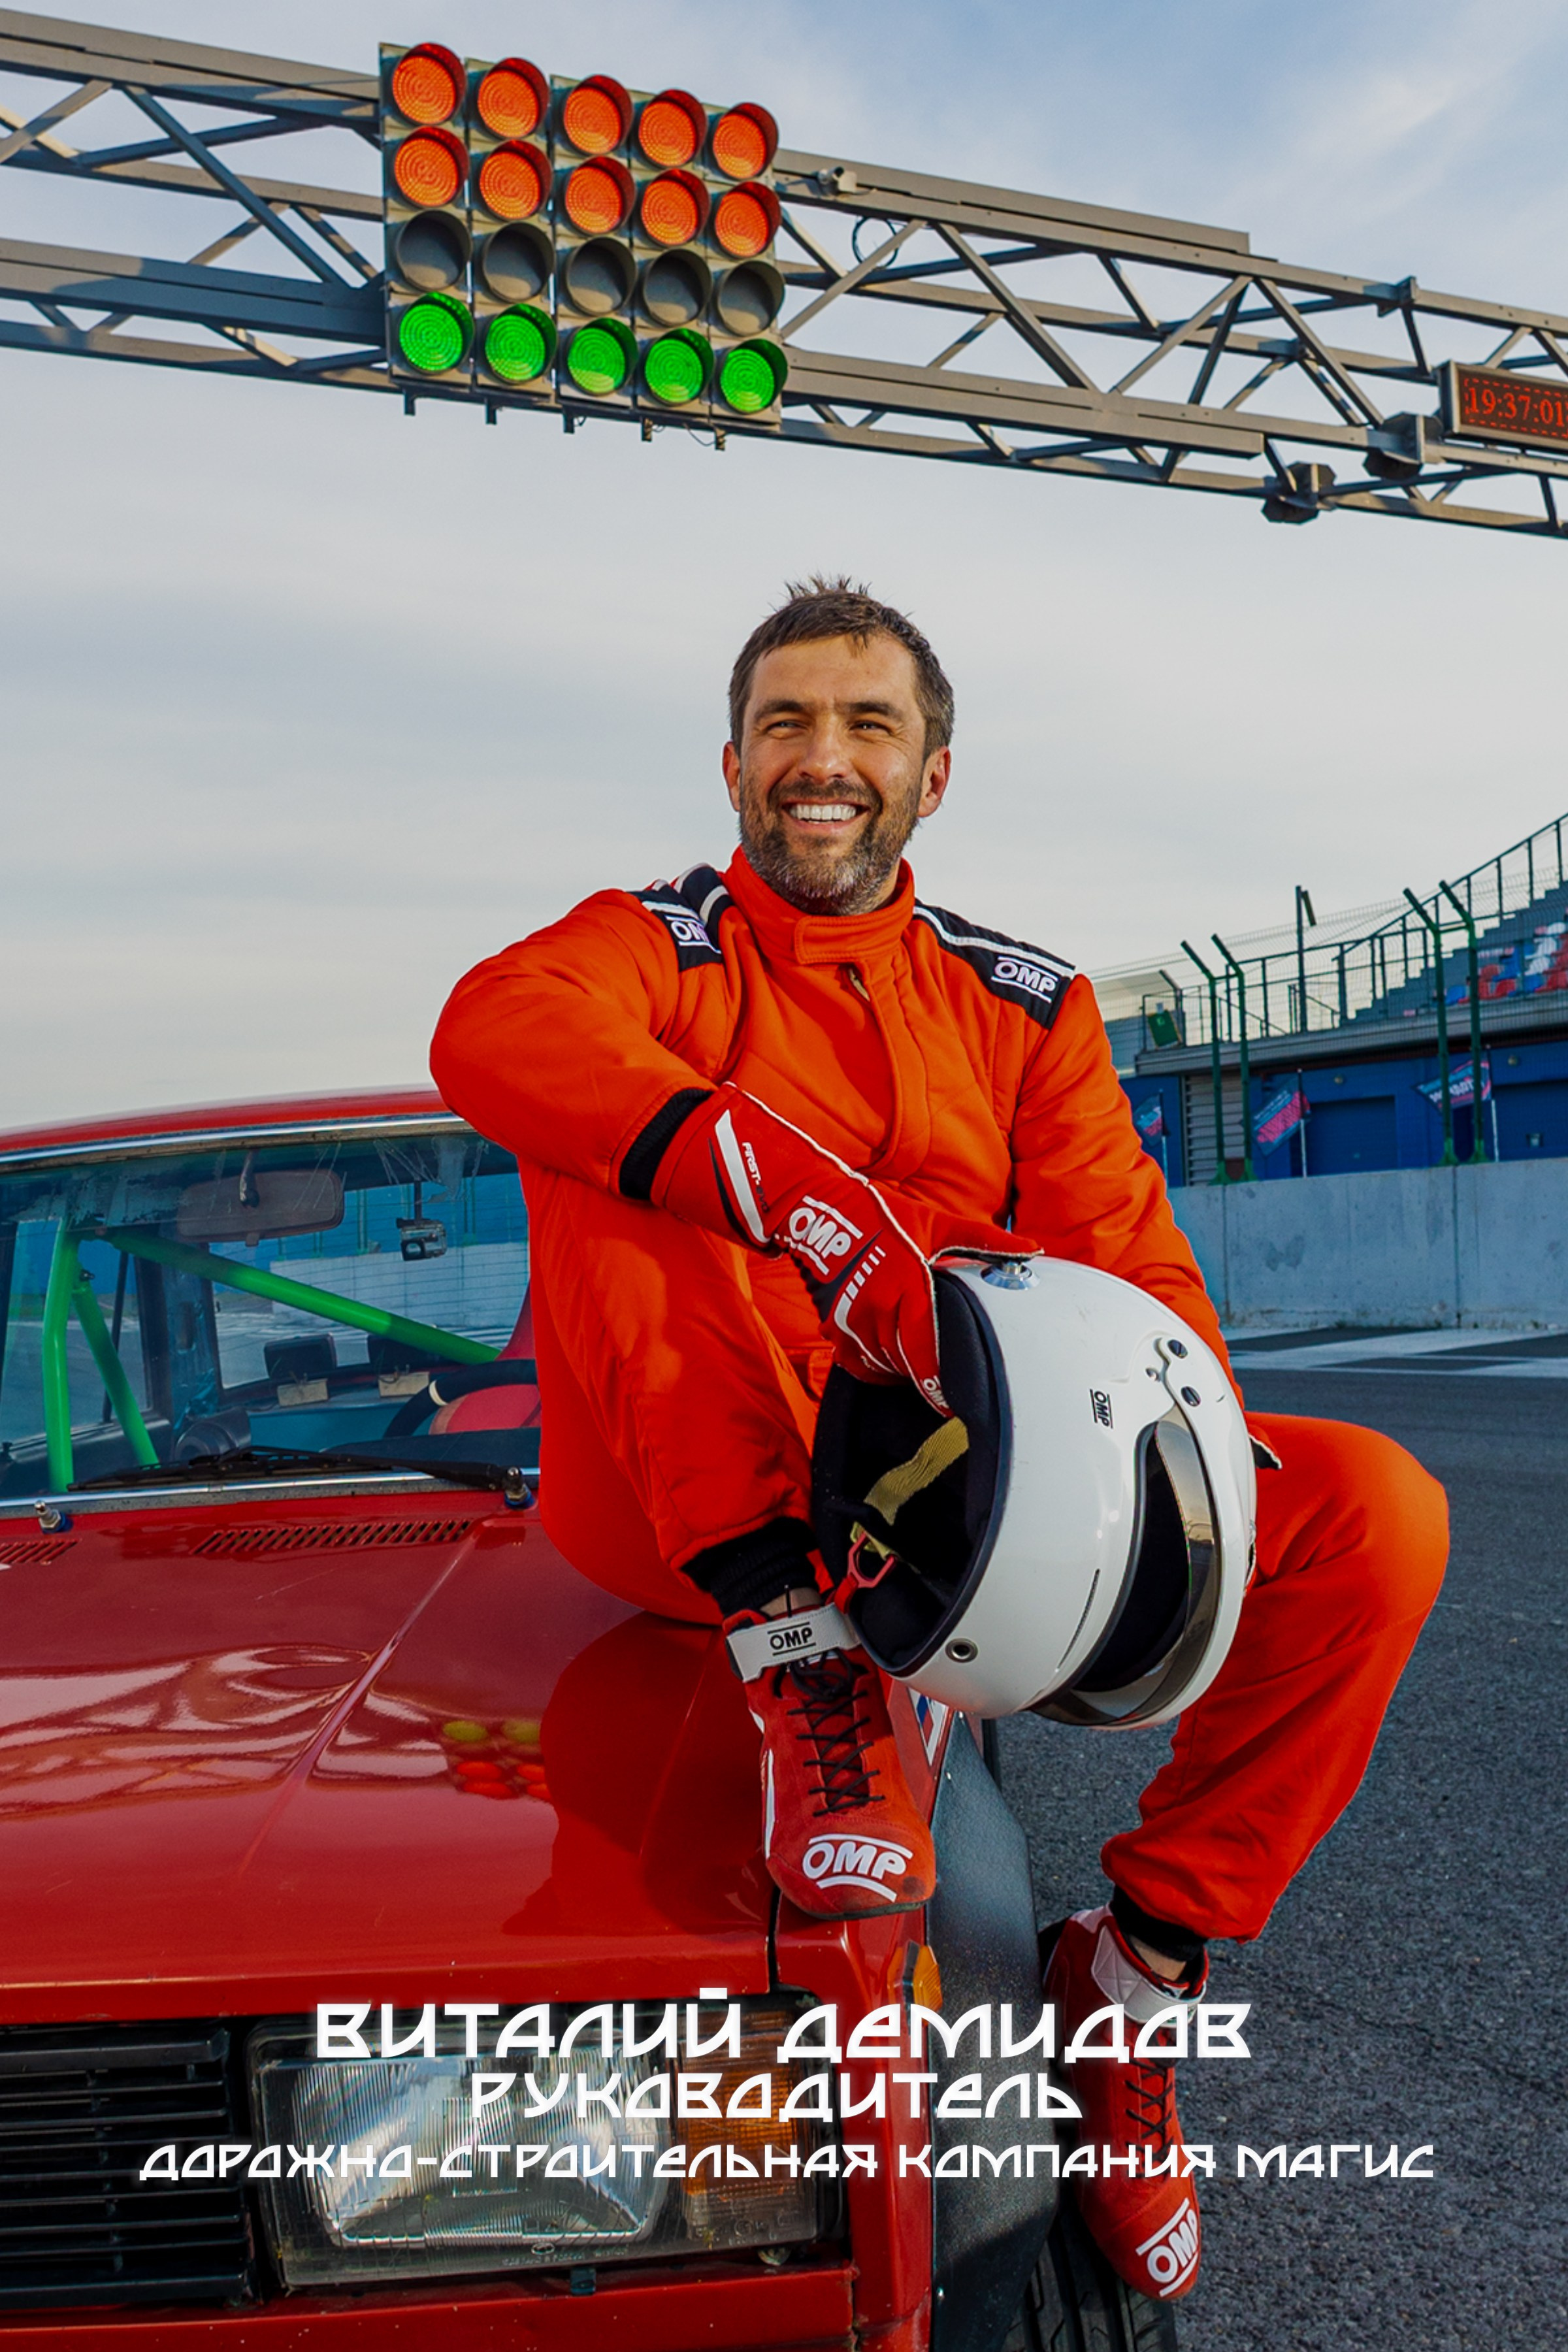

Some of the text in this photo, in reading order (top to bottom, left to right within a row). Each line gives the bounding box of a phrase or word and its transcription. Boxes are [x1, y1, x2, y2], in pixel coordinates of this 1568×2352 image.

[1469, 387, 1565, 427] 19:37:01
[994, 961, 1056, 992] OMP
[789, 1207, 851, 1258] OMP
[1094, 1391, 1109, 1427] OMP
[770, 1627, 812, 1650] OMP
[802, 1841, 906, 1880] OMP
[1147, 2209, 1198, 2283] OMP
